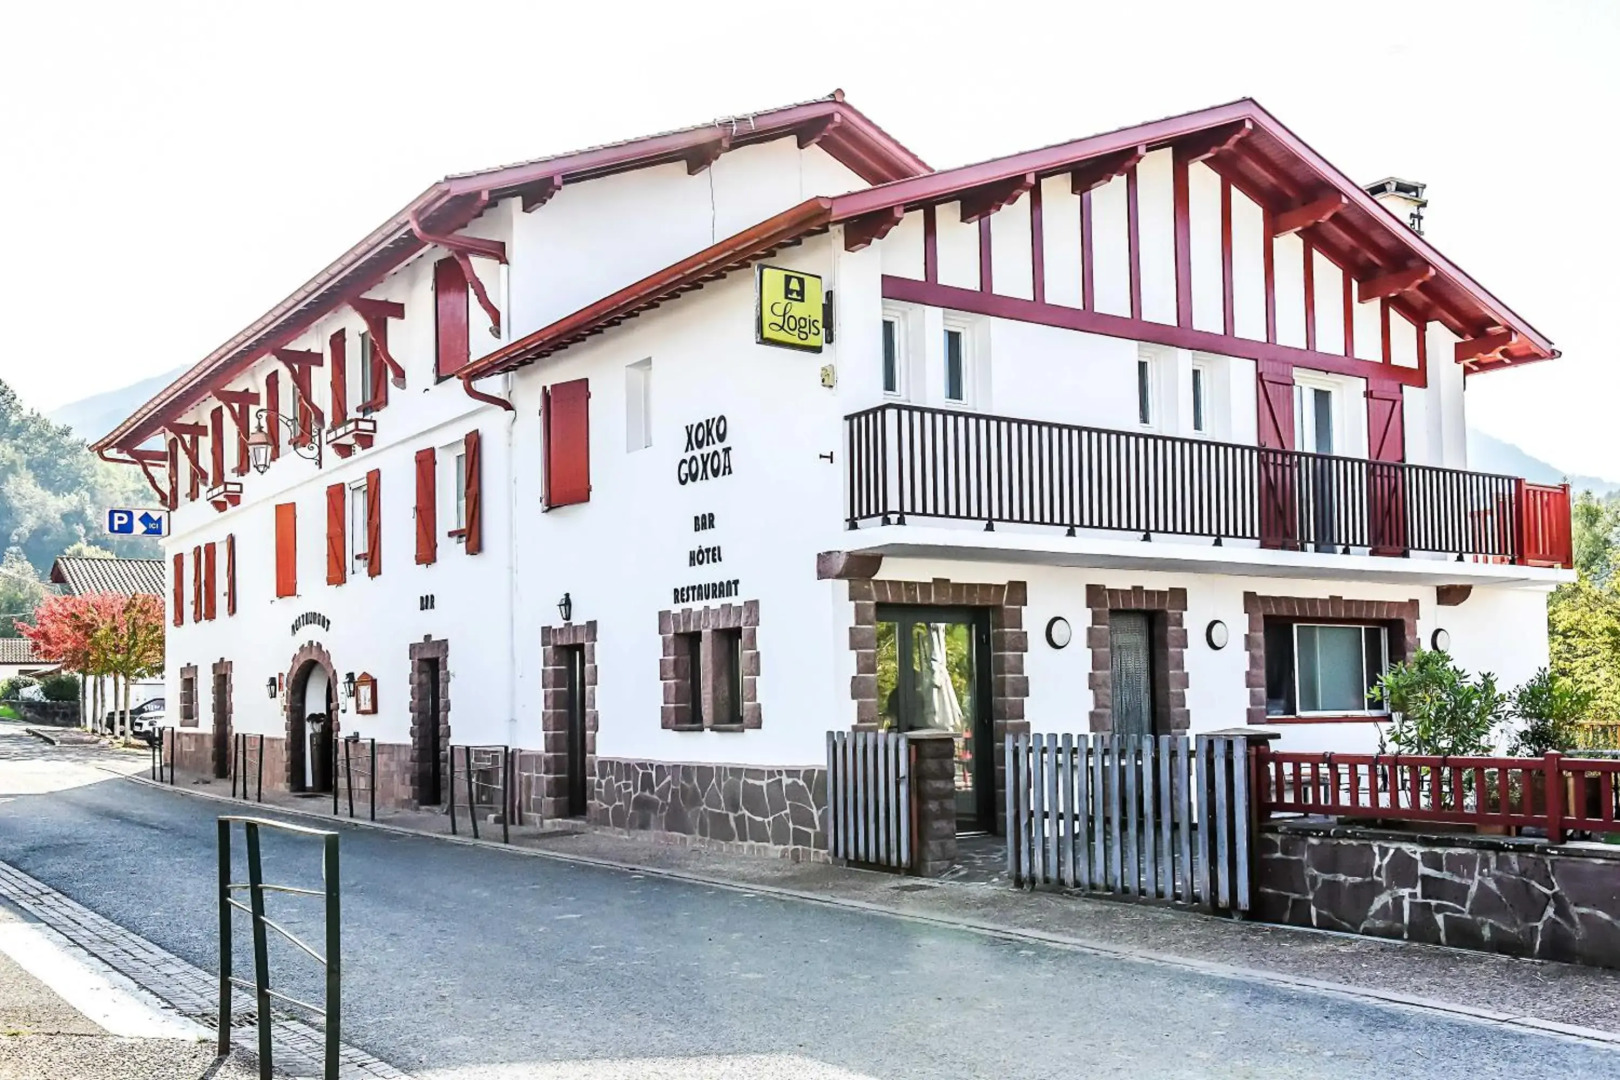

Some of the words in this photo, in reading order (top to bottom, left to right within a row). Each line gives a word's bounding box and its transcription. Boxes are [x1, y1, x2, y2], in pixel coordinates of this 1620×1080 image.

[769, 302, 820, 340] Logis
[685, 415, 728, 453] XOKO
[677, 447, 733, 486] GOXOA
[113, 512, 128, 531] P
[694, 512, 715, 532] BAR
[689, 545, 722, 567] HÔTEL
[420, 594, 435, 611] BAR
[673, 579, 740, 605] RESTAURANT
[291, 611, 331, 636] RESTAURANT
